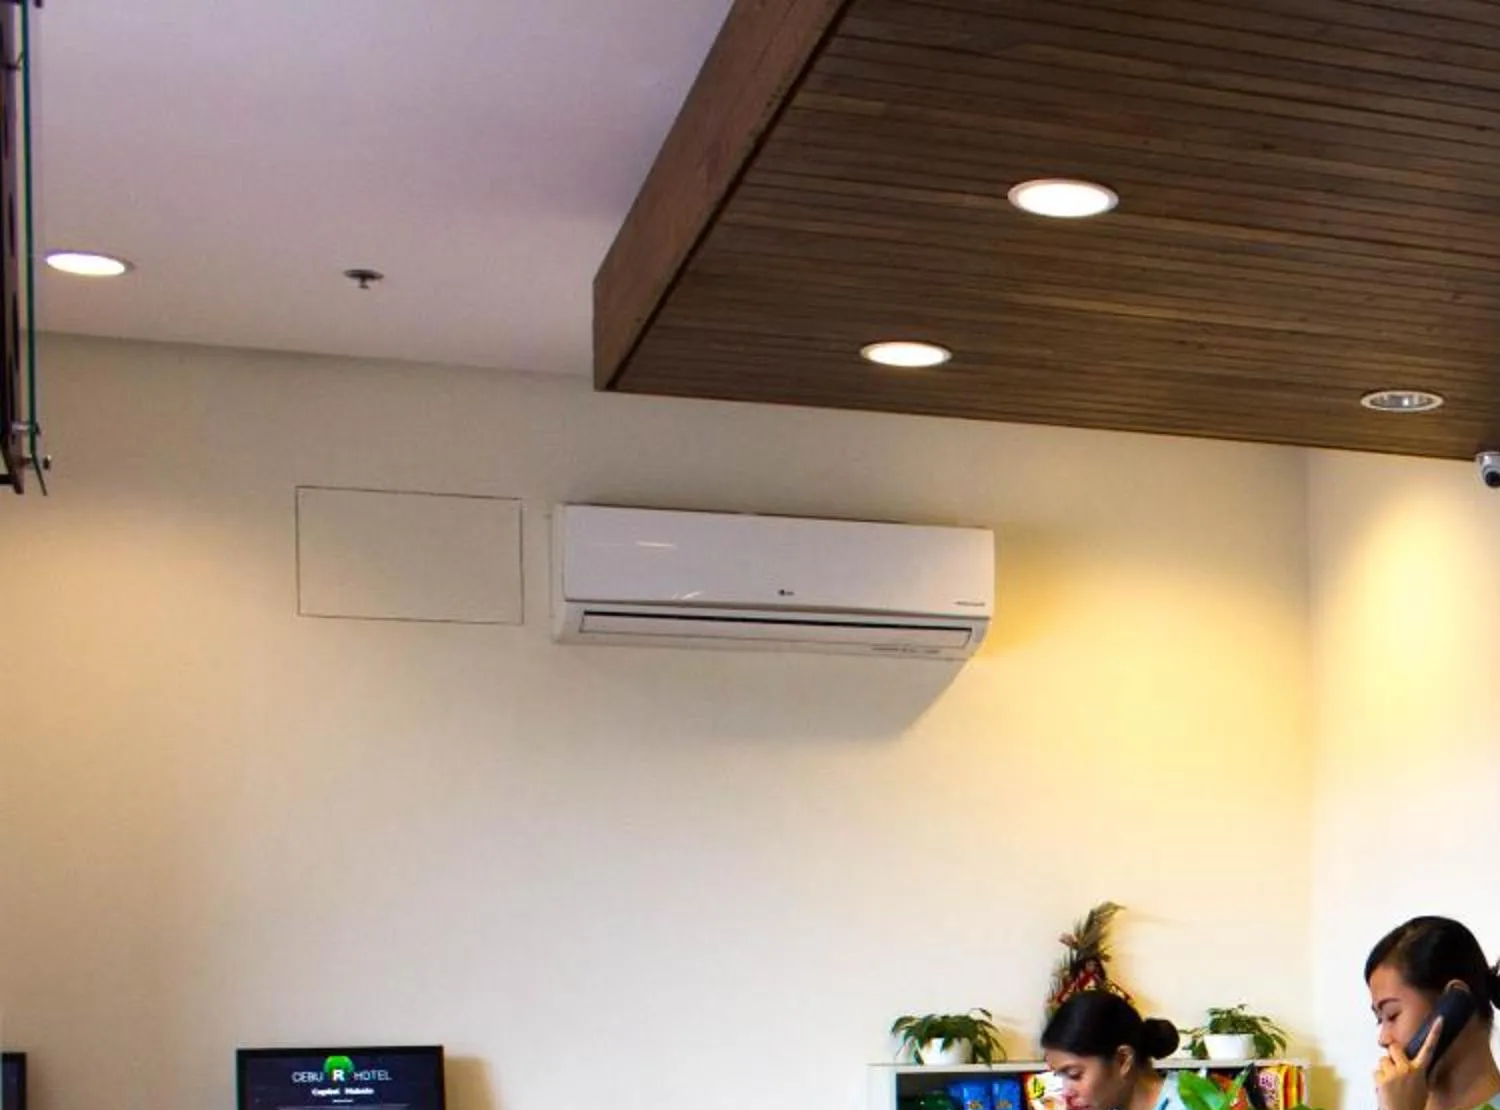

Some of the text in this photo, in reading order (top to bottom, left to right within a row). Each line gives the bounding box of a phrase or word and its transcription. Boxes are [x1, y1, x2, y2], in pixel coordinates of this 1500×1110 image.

[291, 1069, 392, 1083] CEBU R HOTEL
